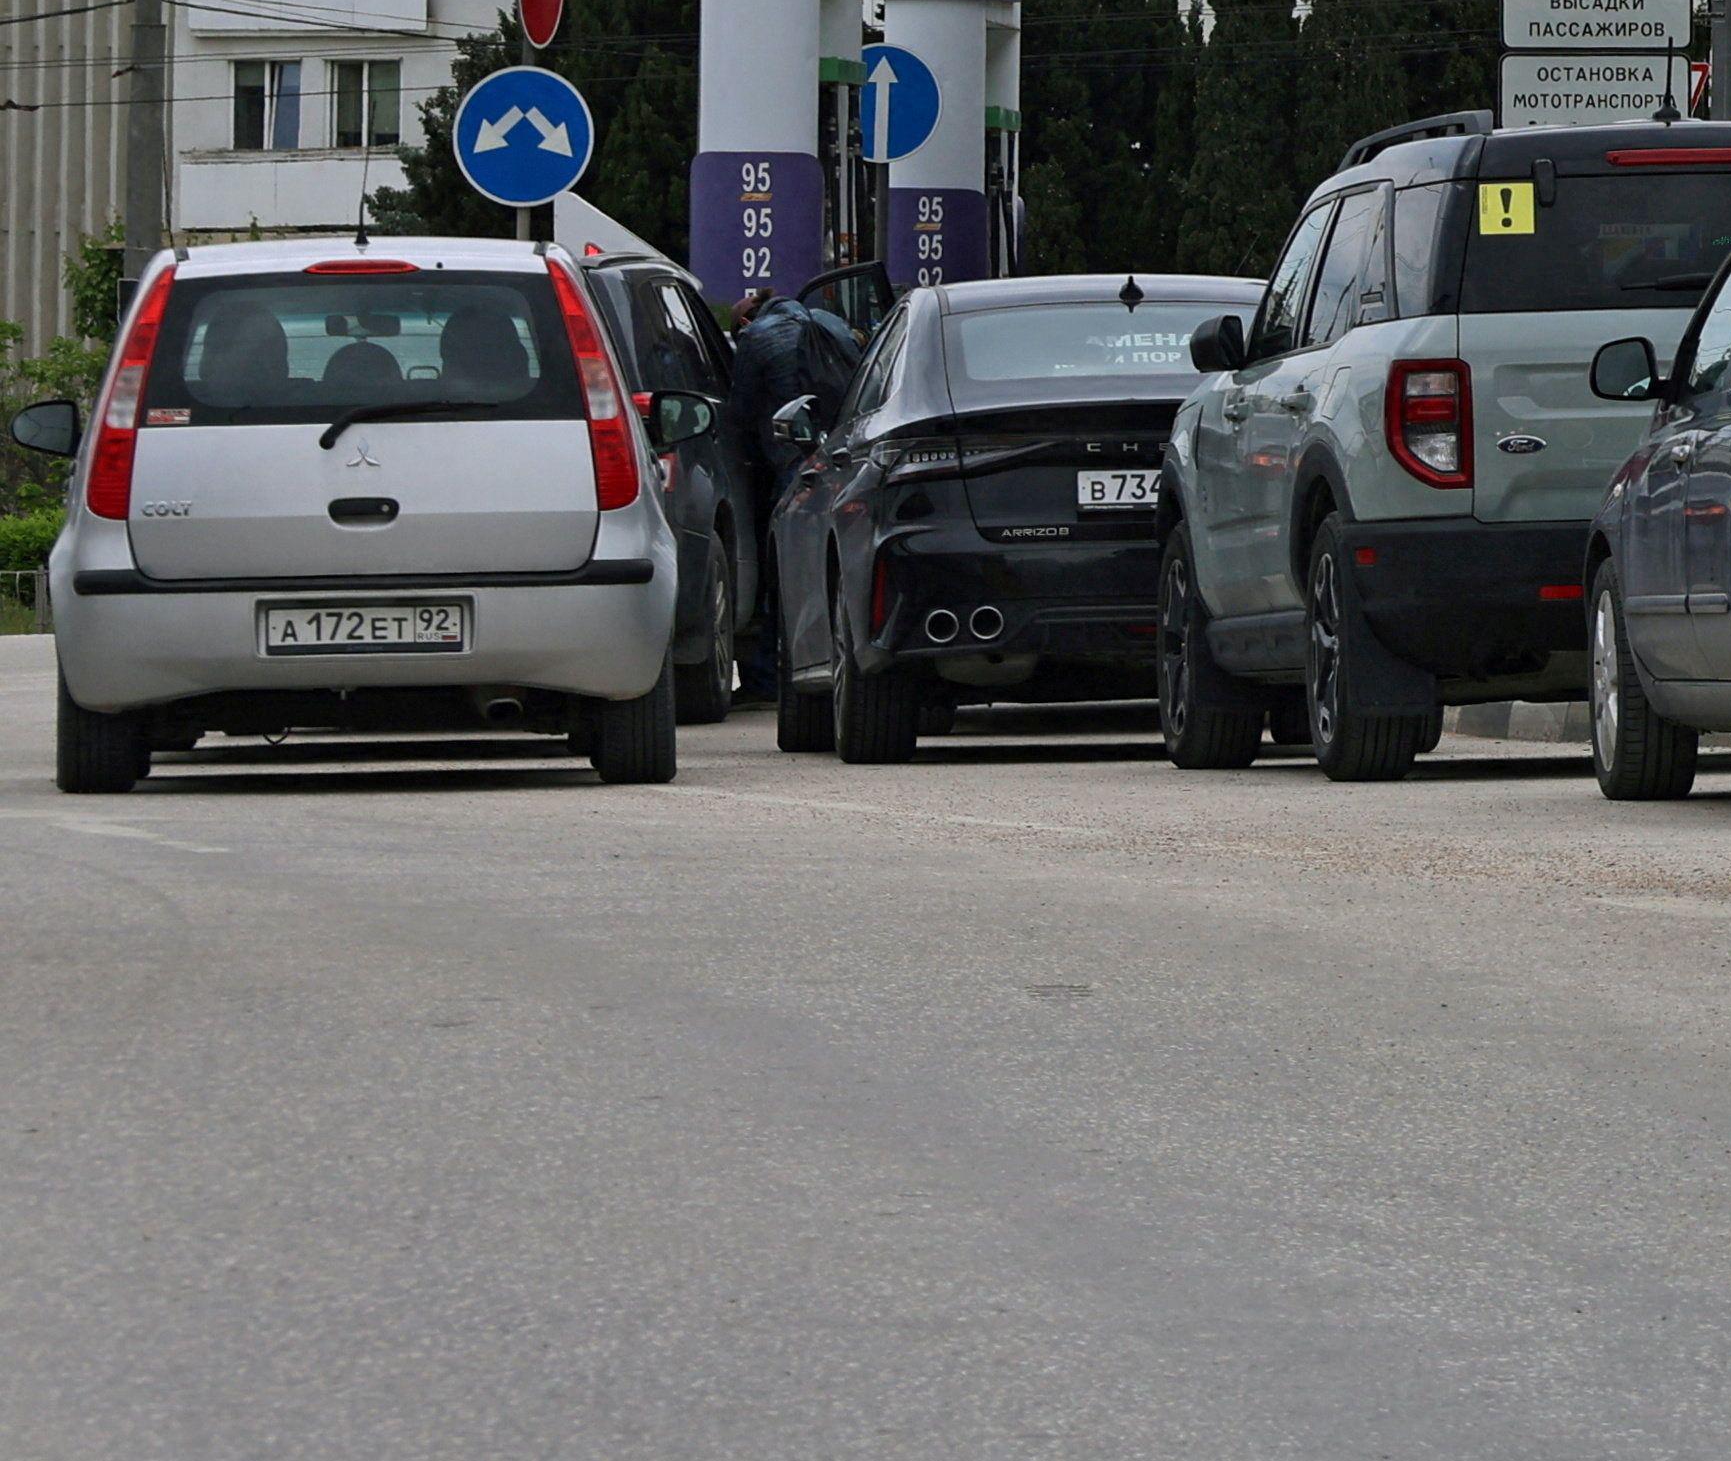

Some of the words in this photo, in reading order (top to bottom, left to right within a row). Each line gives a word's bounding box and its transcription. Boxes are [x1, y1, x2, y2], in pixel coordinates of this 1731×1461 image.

[1529, 22, 1665, 37] ПАССАЖИРОВ
[1537, 67, 1653, 82] ОСТАНОВКА
[742, 162, 771, 192] 95
[918, 196, 943, 222] 95
[743, 207, 773, 238] 95
[918, 234, 943, 261] 95
[742, 247, 771, 278] 92
[142, 500, 192, 517] COLT
[1001, 527, 1057, 537] ARRIZO
[418, 608, 450, 631] 92
[417, 632, 441, 641] RUS
